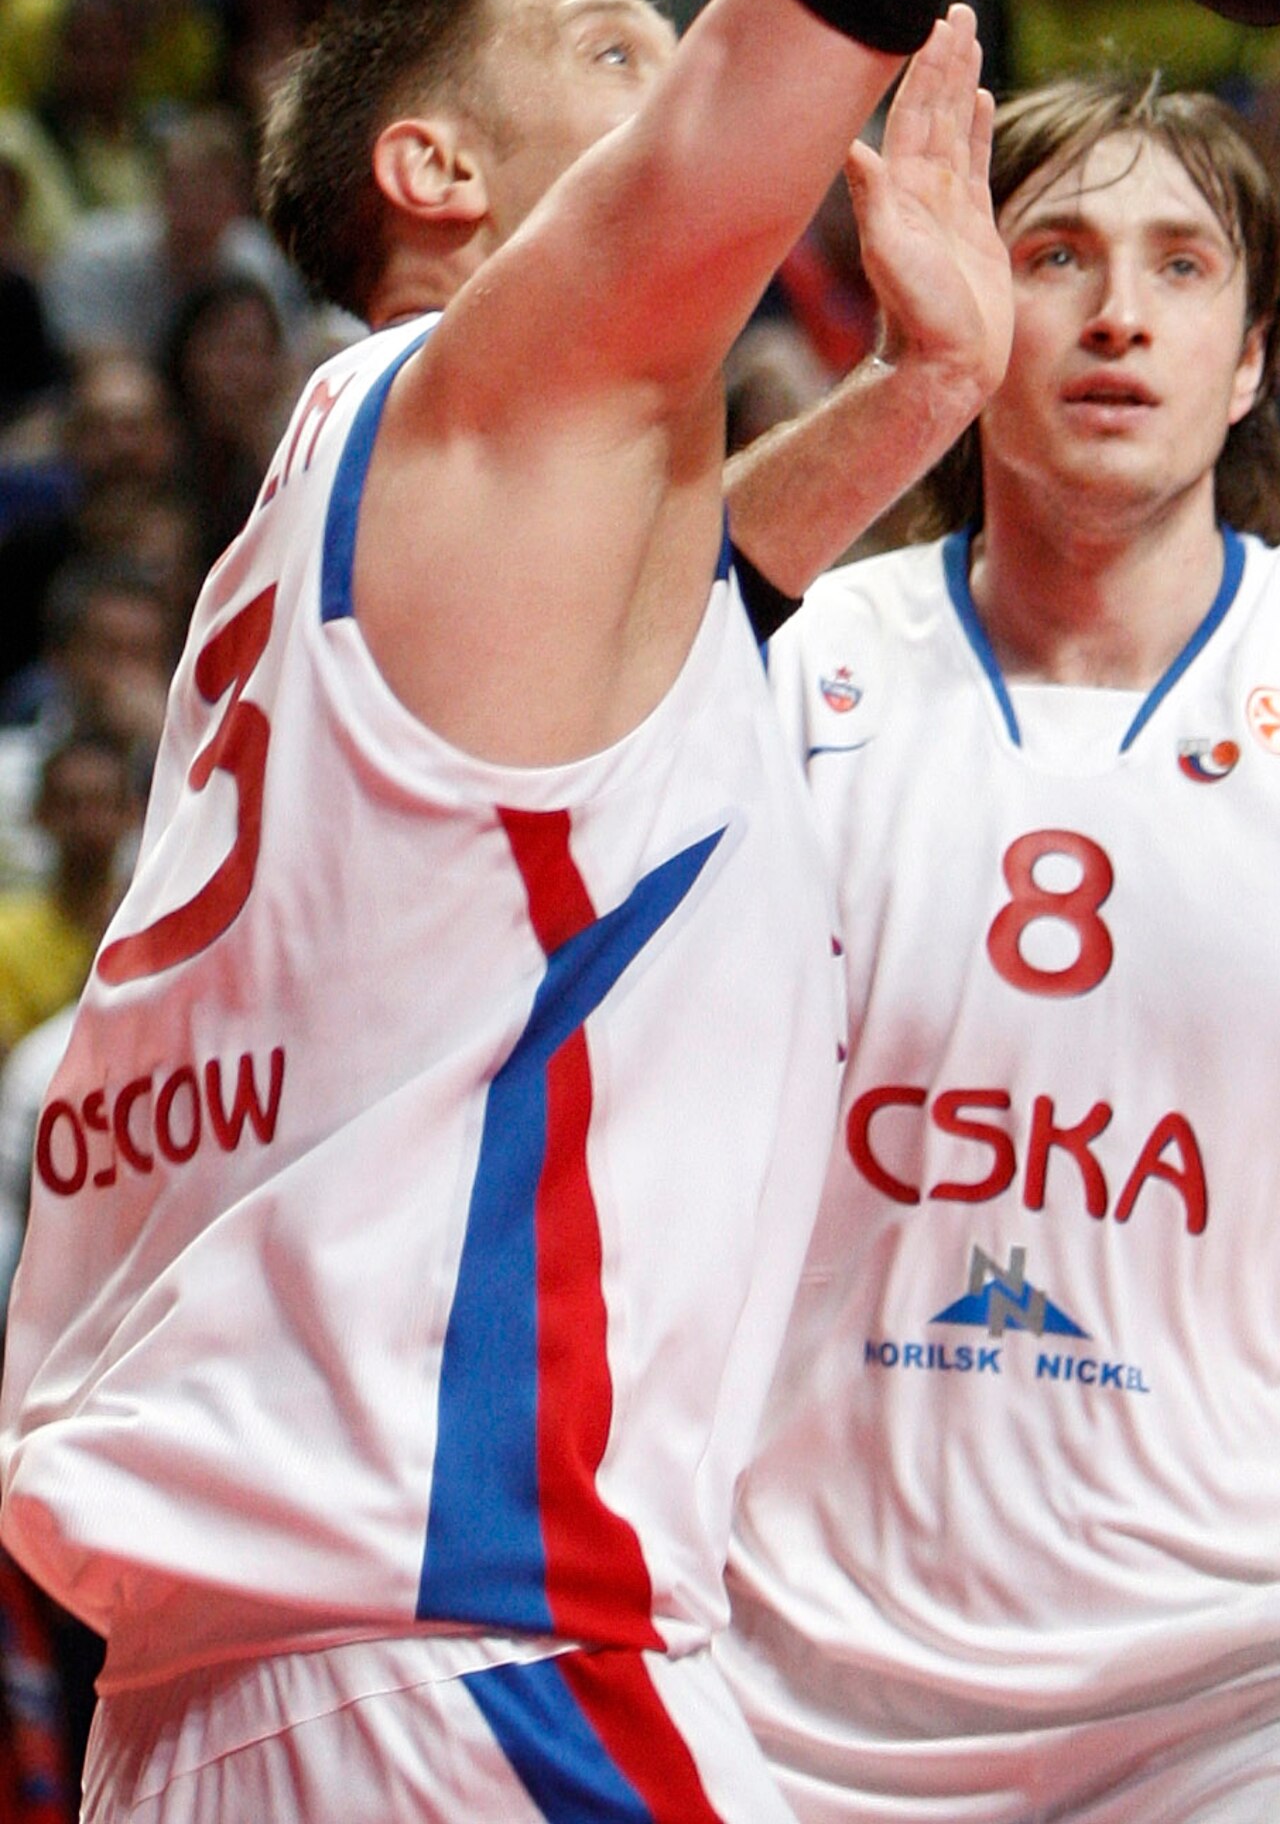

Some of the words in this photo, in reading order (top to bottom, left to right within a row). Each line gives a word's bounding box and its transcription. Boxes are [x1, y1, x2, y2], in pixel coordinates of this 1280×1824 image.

[987, 828, 1114, 998] 8
[846, 1085, 1208, 1236] CSKA
[1036, 1353, 1150, 1393] NICKEL
